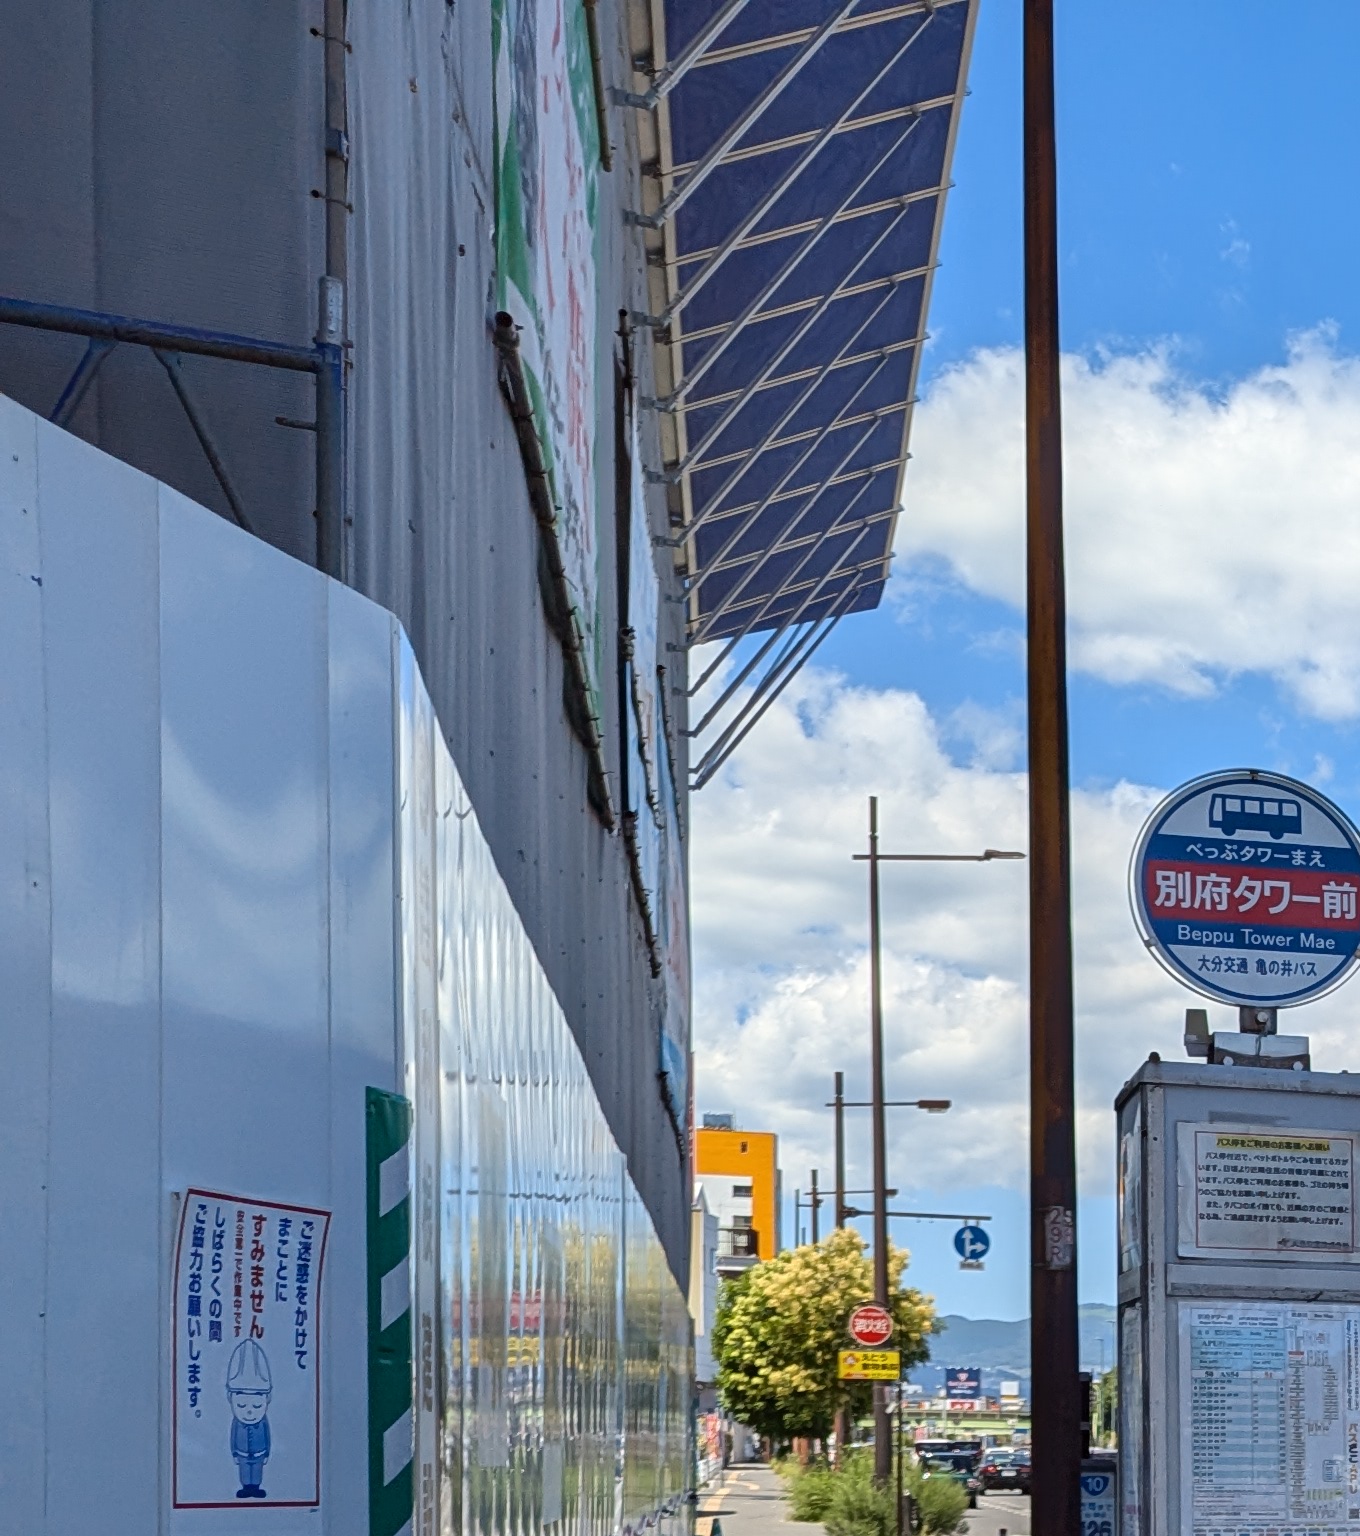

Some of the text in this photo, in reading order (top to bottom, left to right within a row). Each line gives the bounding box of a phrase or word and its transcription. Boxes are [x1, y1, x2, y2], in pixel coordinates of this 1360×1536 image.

[1186, 843, 1326, 868] べっぷタワーまえ
[1154, 869, 1358, 920] 別府タワー前
[1177, 924, 1336, 950] Beppu Tower Mae
[1197, 955, 1318, 977] 大分交通 亀の井バス
[209, 1206, 226, 1343] しばらくの間
[249, 1213, 267, 1339] すみません
[275, 1217, 293, 1302] まことに
[187, 1204, 207, 1418] ご協力お願いします。
[294, 1220, 314, 1370] ご迷惑をかけて
[1087, 1477, 1104, 1492] 10
